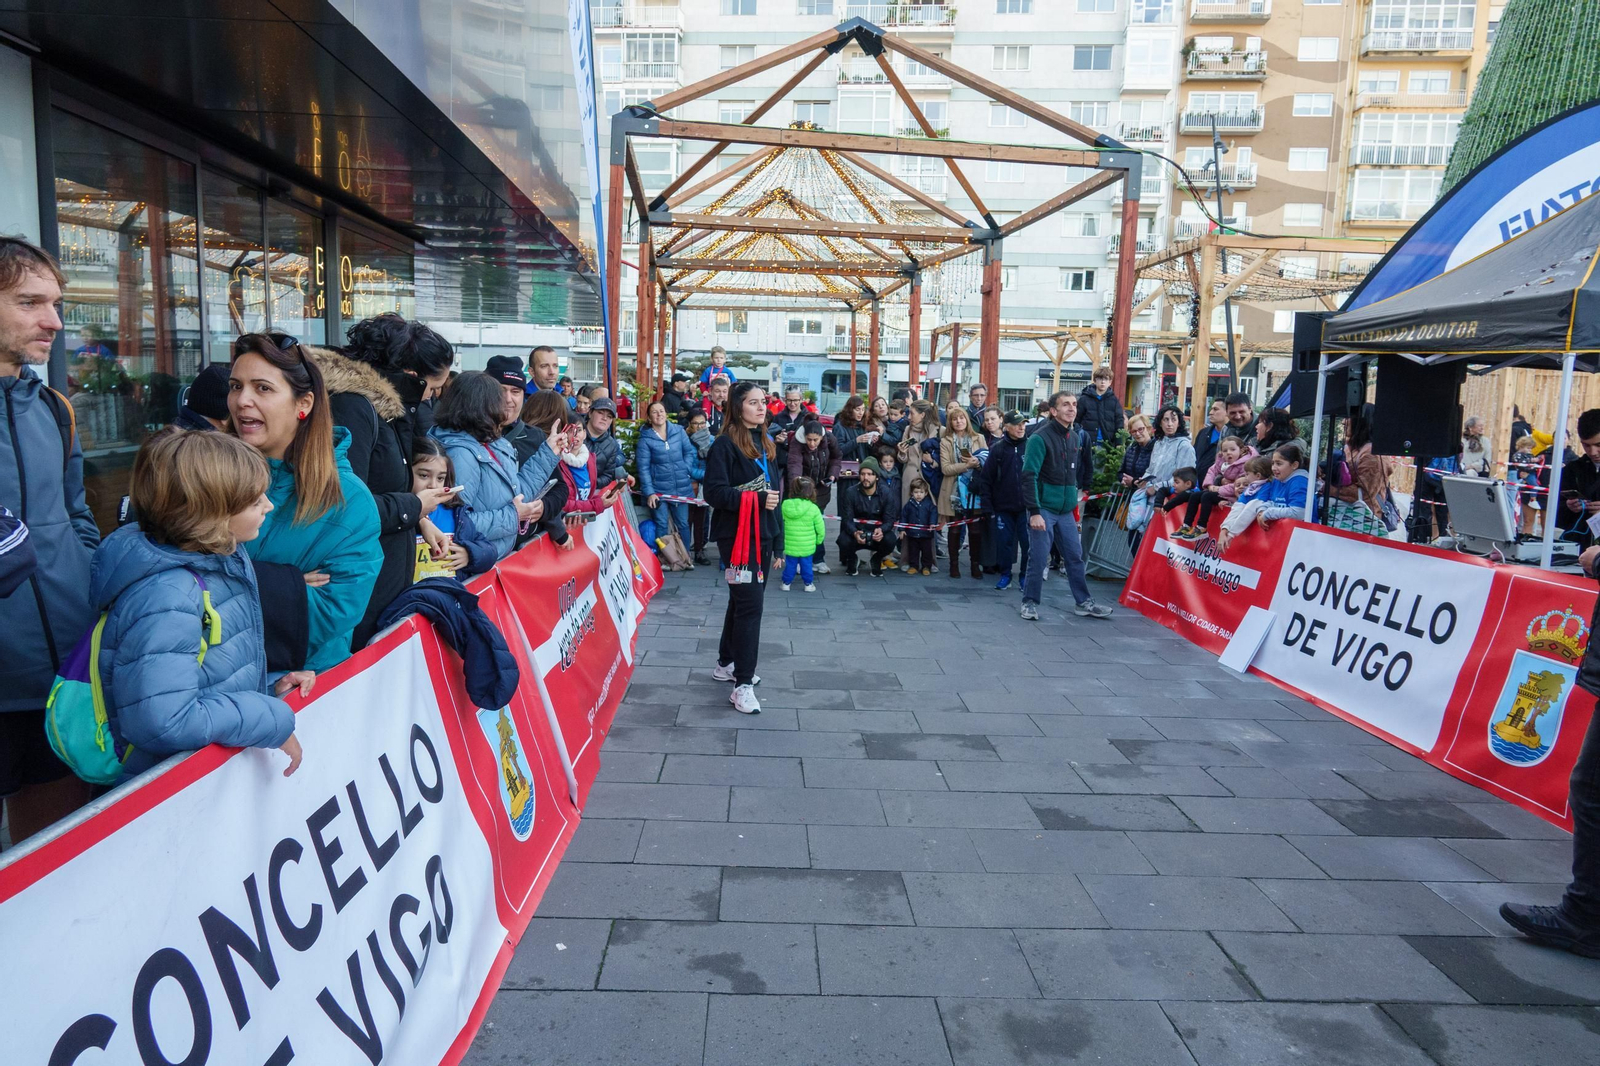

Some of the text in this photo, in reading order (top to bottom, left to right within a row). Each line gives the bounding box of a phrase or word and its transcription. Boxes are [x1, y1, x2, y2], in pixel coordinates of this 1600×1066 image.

[1166, 547, 1241, 594] terreo de xogo
[1287, 561, 1458, 645] CONCELLO
[1196, 618, 1220, 635] CIDADE
[1282, 611, 1413, 692] DE VIGO
[316, 854, 454, 1066] VIGO
